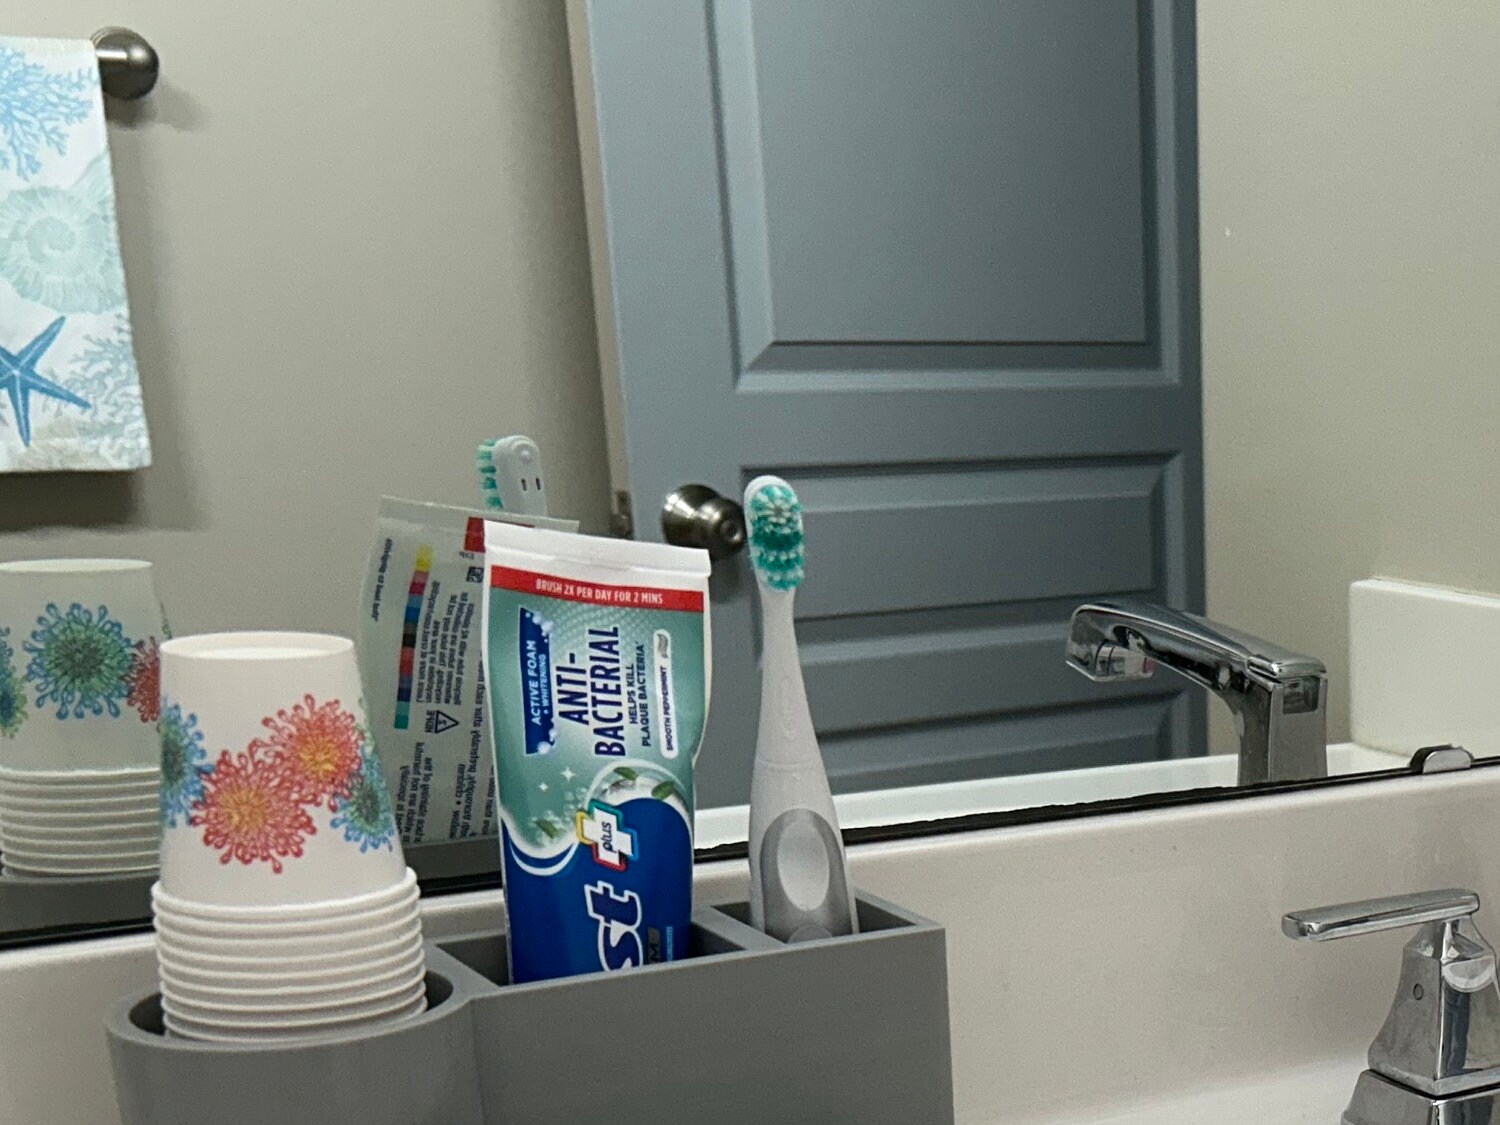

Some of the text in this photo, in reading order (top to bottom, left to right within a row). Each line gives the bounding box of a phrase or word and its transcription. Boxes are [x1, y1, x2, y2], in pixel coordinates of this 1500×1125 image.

[536, 579, 662, 604] BRUSH 2X PER DAY FOR 2 MINS
[526, 640, 540, 725] ACTIVE FOAM
[539, 654, 548, 706] WHITENING
[556, 653, 588, 724] ANTI-
[589, 628, 625, 755] BACTERIAL
[626, 663, 637, 724] HELPS KILL
[660, 666, 673, 751] SMOOTH PEPPERMINT
[639, 703, 650, 746] PLAQUE
[601, 822, 616, 853] plus
